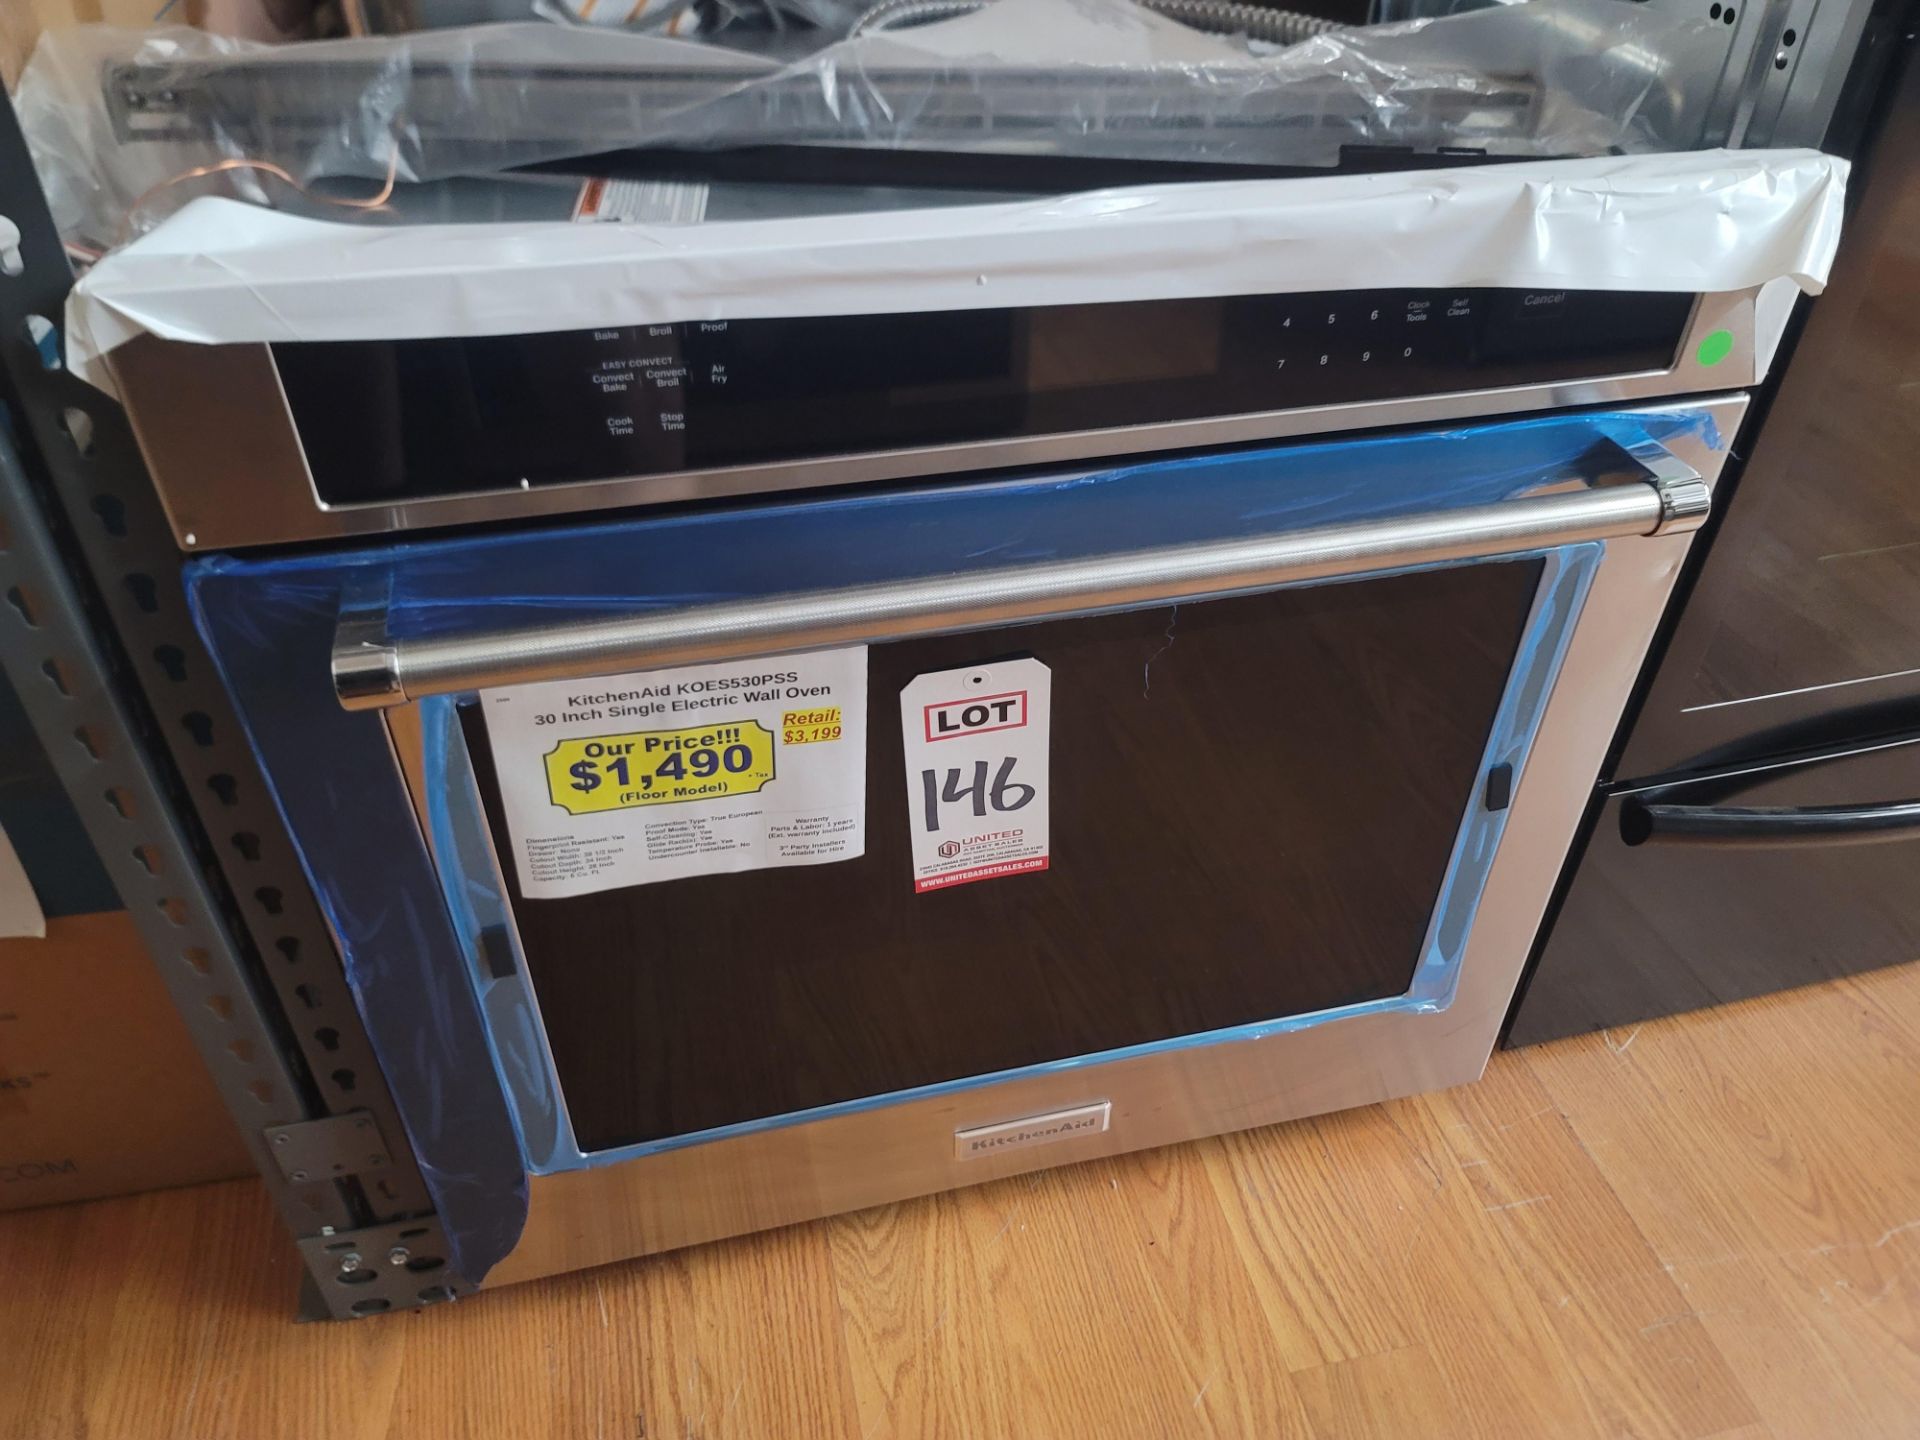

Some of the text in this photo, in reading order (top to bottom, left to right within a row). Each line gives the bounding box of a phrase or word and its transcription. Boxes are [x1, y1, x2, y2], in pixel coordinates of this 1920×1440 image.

[1452, 298, 1469, 308] Self
[1524, 292, 1566, 306] Cancel
[1407, 300, 1430, 310] Clock
[1406, 313, 1427, 322] Tools
[1447, 307, 1470, 317] Clean
[1283, 310, 1378, 328] 4 5 6
[649, 326, 672, 337] Broil
[701, 322, 728, 332] Proof
[594, 331, 619, 341] Bake
[1278, 347, 1412, 368] 7 8 9 0
[602, 357, 672, 370] EASY CONVECT
[712, 364, 724, 373] Air
[592, 372, 634, 384] Convect
[646, 368, 687, 379] Convect
[656, 378, 680, 388] Broil
[712, 375, 728, 384] Fry
[603, 384, 627, 392] Bake
[607, 417, 634, 427] Cook
[660, 412, 684, 422] Stop
[610, 427, 634, 436] Time
[662, 422, 685, 431] Time
[568, 672, 798, 707] KitchenAid KOES530PSS
[534, 686, 831, 726] 30 Inch Single Electric Wall Oven
[783, 709, 842, 726] Retail:
[938, 700, 1016, 732] LOT
[784, 726, 842, 744] $3,199
[584, 728, 740, 758] Our Price!!!
[569, 744, 753, 794] $1,490
[620, 782, 728, 804] (Floor Model)
[922, 756, 1036, 832] 146
[728, 810, 763, 820] European
[796, 816, 830, 824] Warranty
[833, 818, 854, 826] years
[788, 830, 820, 838] warranty
[822, 824, 856, 834] included)
[962, 828, 1024, 845] UNITED
[812, 840, 846, 848] Installers
[920, 860, 1043, 888] WWW.UNITEDASSETSALES.COM
[972, 1118, 1096, 1150] KitchenAid
